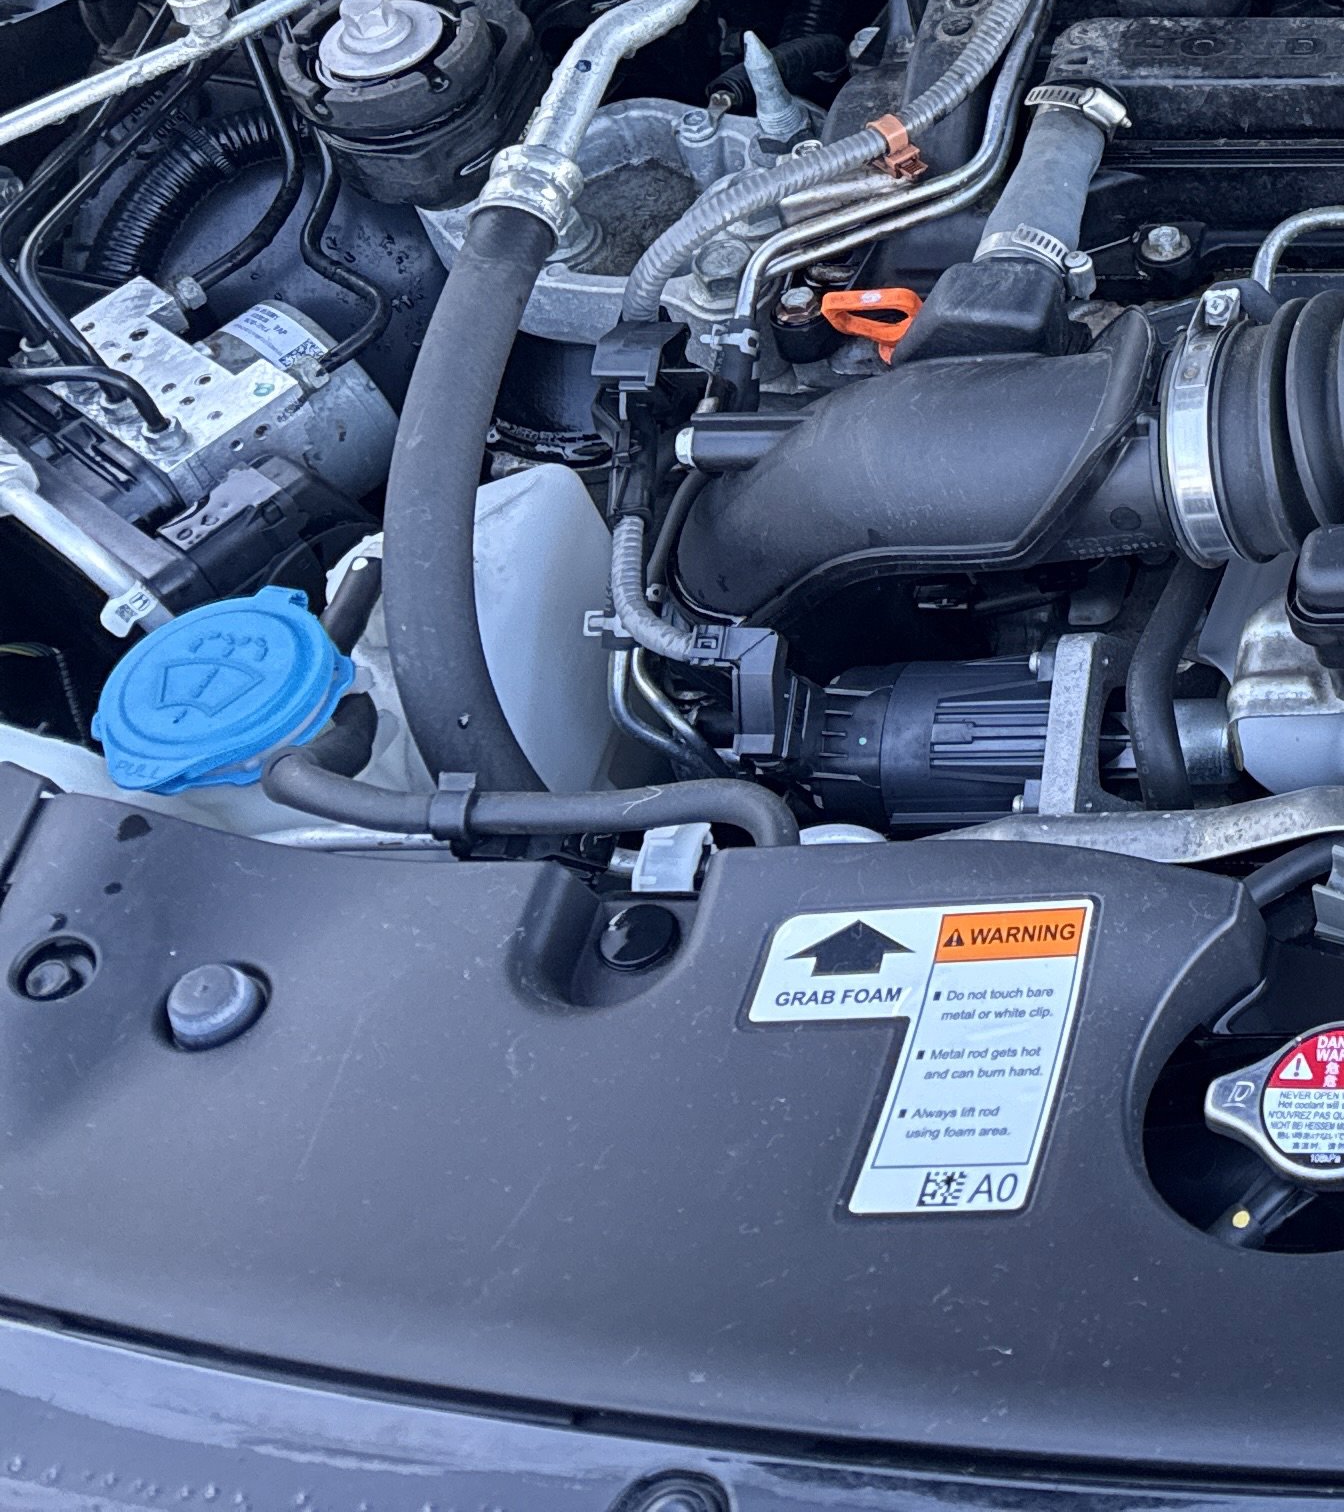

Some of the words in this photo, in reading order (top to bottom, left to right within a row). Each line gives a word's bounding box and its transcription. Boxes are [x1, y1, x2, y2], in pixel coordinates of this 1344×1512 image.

[970, 923, 1076, 945] WARNING
[775, 989, 834, 1007] GRAB
[841, 987, 902, 1004] FOAM
[946, 990, 965, 1001] Do
[967, 989, 987, 1001] not
[990, 988, 1023, 1000] touch
[1026, 986, 1054, 998] bare
[941, 1009, 976, 1020] metal
[978, 1010, 992, 1019] or
[994, 1007, 1026, 1018] white
[1029, 1006, 1053, 1019] clip.
[930, 1048, 965, 1060] Metal
[967, 1048, 988, 1058] rod
[990, 1047, 1018, 1061] gets
[1021, 1046, 1041, 1057] hot
[924, 1068, 949, 1080] and
[951, 1069, 974, 1079] can
[977, 1068, 1005, 1078] burn
[1008, 1065, 1043, 1077] hand.
[1279, 1091, 1311, 1100] NEVER
[1313, 1091, 1339, 1100] OPEN
[1277, 1100, 1293, 1109] Hot
[1294, 1100, 1324, 1109] coolant
[1326, 1100, 1339, 1109] will
[911, 1108, 957, 1121] Always
[960, 1106, 976, 1117] lift
[978, 1105, 1000, 1117] rod
[1313, 1111, 1331, 1120] PAS
[905, 1127, 941, 1140] using
[943, 1126, 976, 1138] foam
[978, 1126, 1011, 1137] area.
[1270, 1121, 1291, 1130] NICHT
[966, 1172, 1019, 1204] A0
